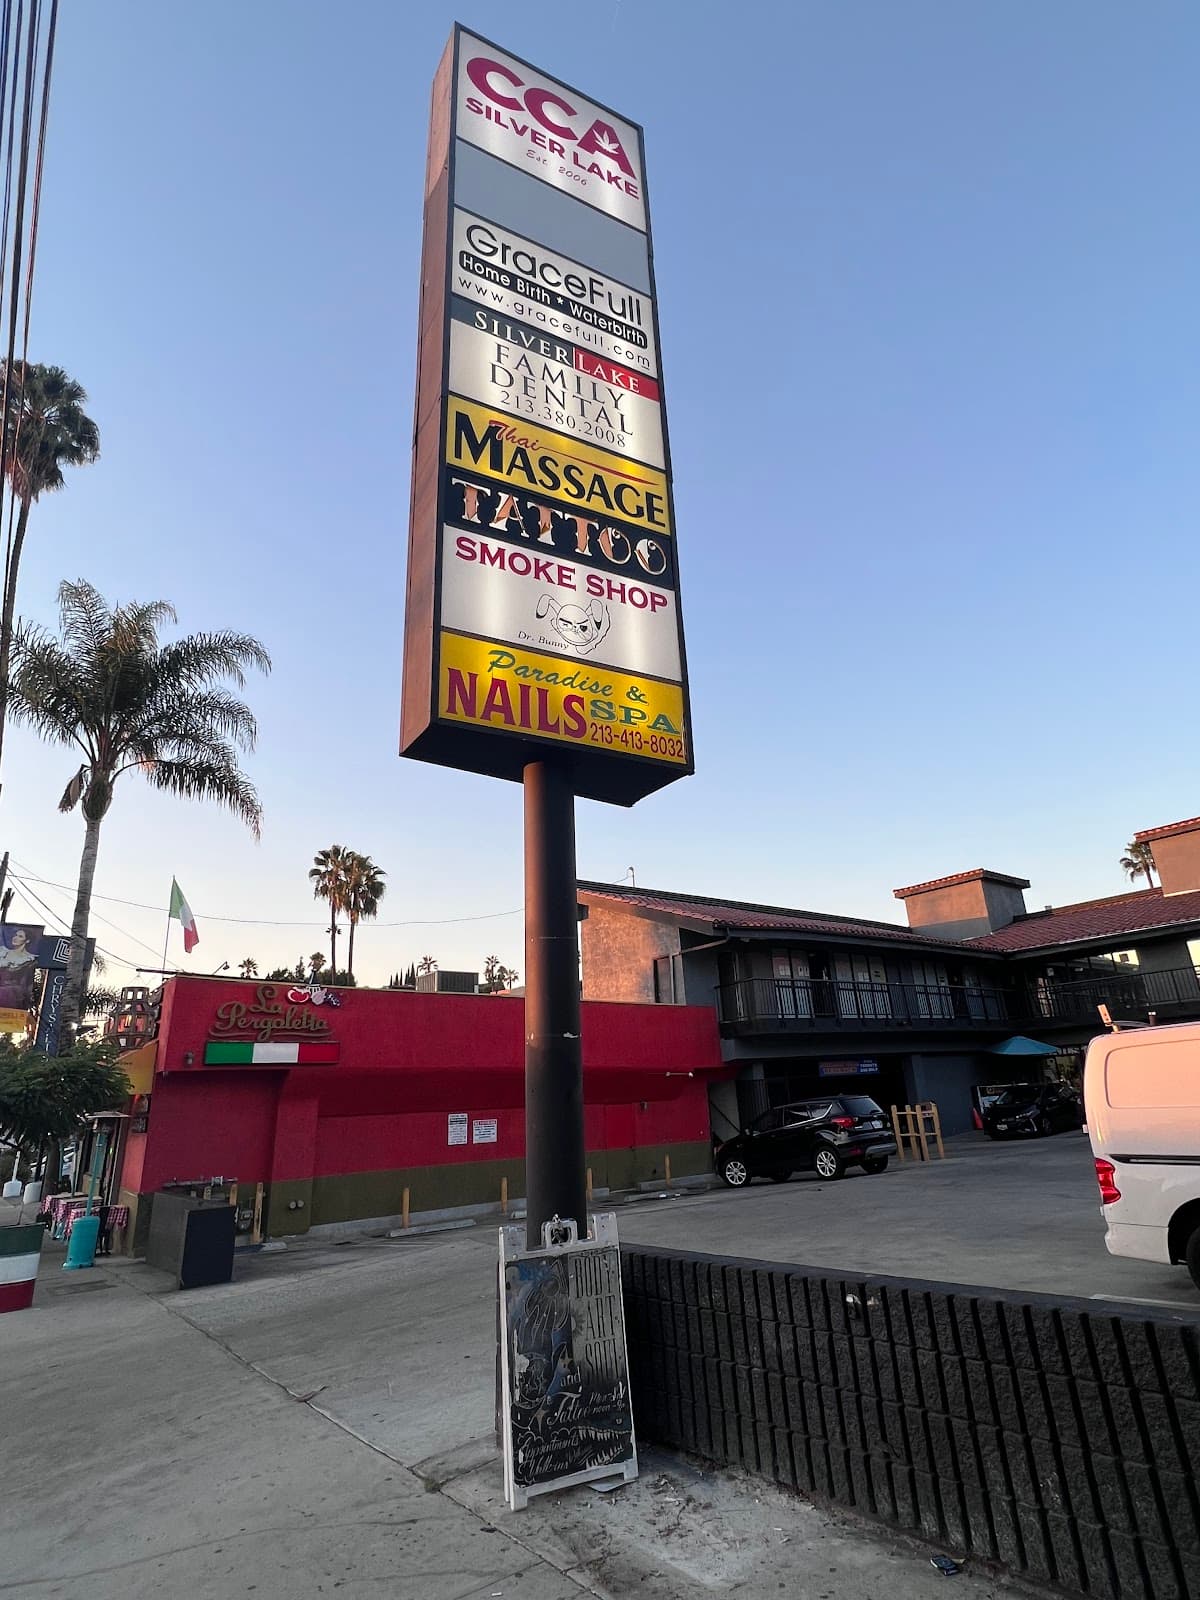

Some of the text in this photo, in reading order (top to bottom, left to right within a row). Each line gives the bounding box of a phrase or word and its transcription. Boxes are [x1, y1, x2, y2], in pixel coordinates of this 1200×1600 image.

[466, 57, 637, 180] CCA
[466, 97, 640, 200] SILVER LAKE
[558, 166, 587, 186] 2006
[463, 254, 645, 347] Home Birth Waterbirth
[466, 224, 642, 326] GraceFull
[458, 277, 651, 369] www.gracefull.com
[474, 310, 640, 394] SILVER LAKE
[489, 362, 633, 436] DENTAL
[495, 343, 625, 410] FAMILY
[488, 420, 541, 450] Thai
[500, 390, 626, 448] 213.380.2008
[454, 410, 666, 528] MASSAGE
[451, 477, 668, 576] TATTOO
[455, 536, 668, 613] SMOKE SHOP
[517, 631, 570, 650] Dr. Bunny
[446, 667, 681, 739] NAILS SPA
[487, 649, 649, 705] Paradise &
[590, 722, 684, 758] 213-413-8032
[248, 985, 282, 1014] La
[575, 1254, 613, 1299] BODY
[585, 1296, 616, 1342] ART
